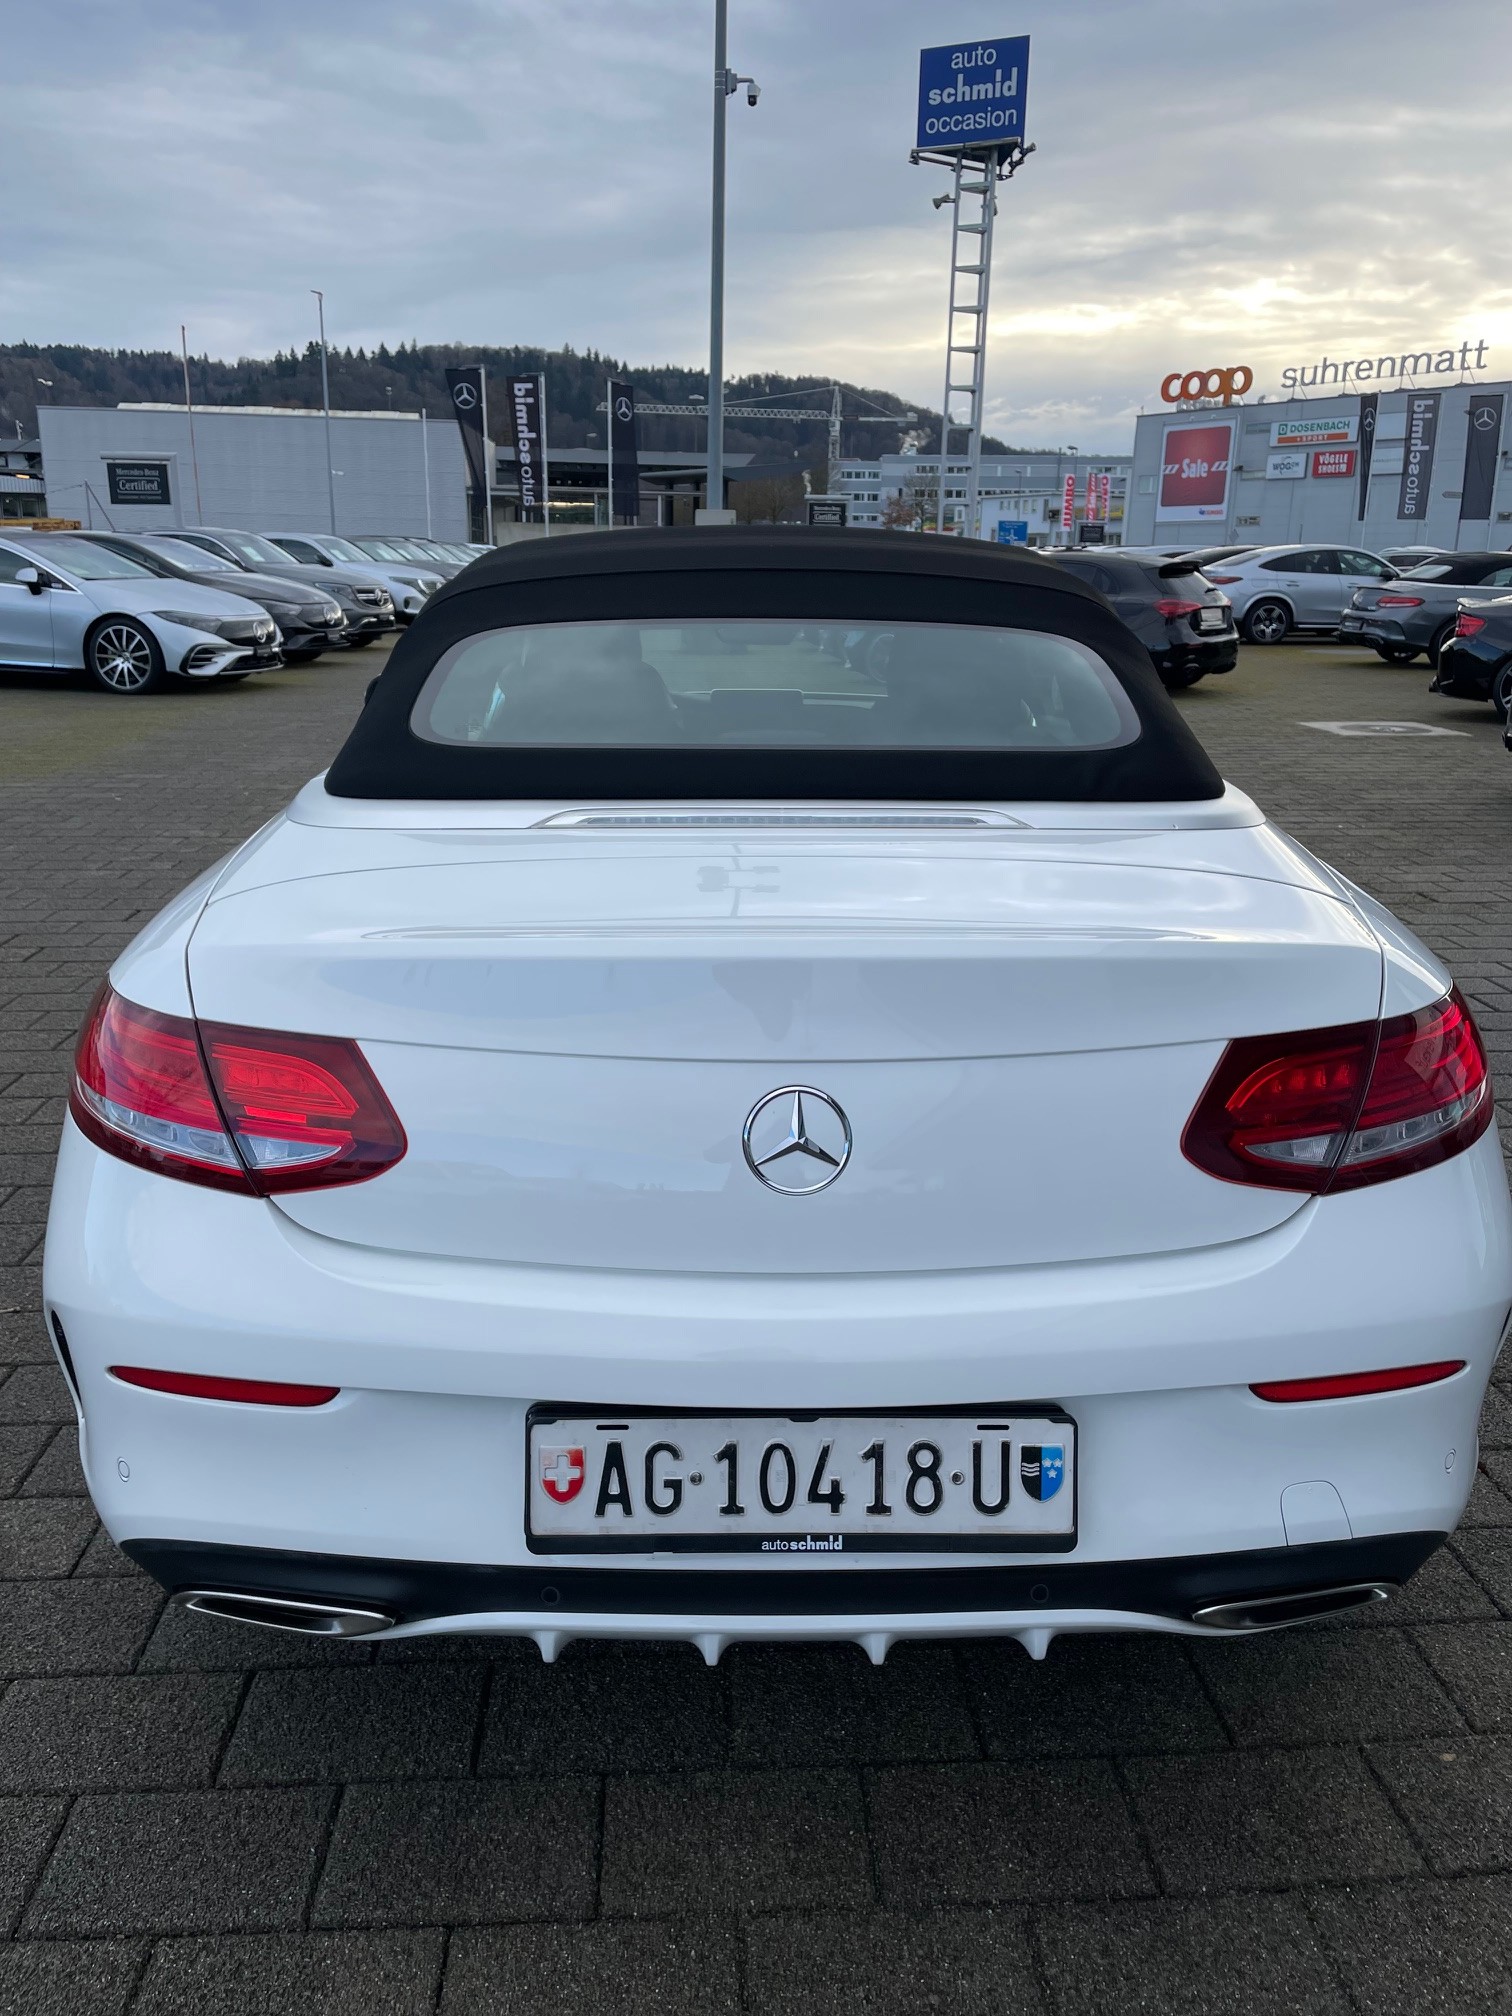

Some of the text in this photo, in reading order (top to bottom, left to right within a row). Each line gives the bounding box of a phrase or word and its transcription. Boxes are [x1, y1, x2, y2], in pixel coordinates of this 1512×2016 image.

[951, 46, 997, 69] auto
[928, 67, 1018, 105] schmid
[925, 107, 1017, 134] occasion
[1281, 339, 1489, 388] suhrenmatt
[1161, 366, 1253, 407] coop
[1290, 420, 1350, 433] DOSENBACH
[1181, 458, 1208, 479] Sale
[1319, 453, 1348, 465] VÖGELE
[119, 480, 158, 491] Certified
[1063, 475, 1075, 527] JUMBO
